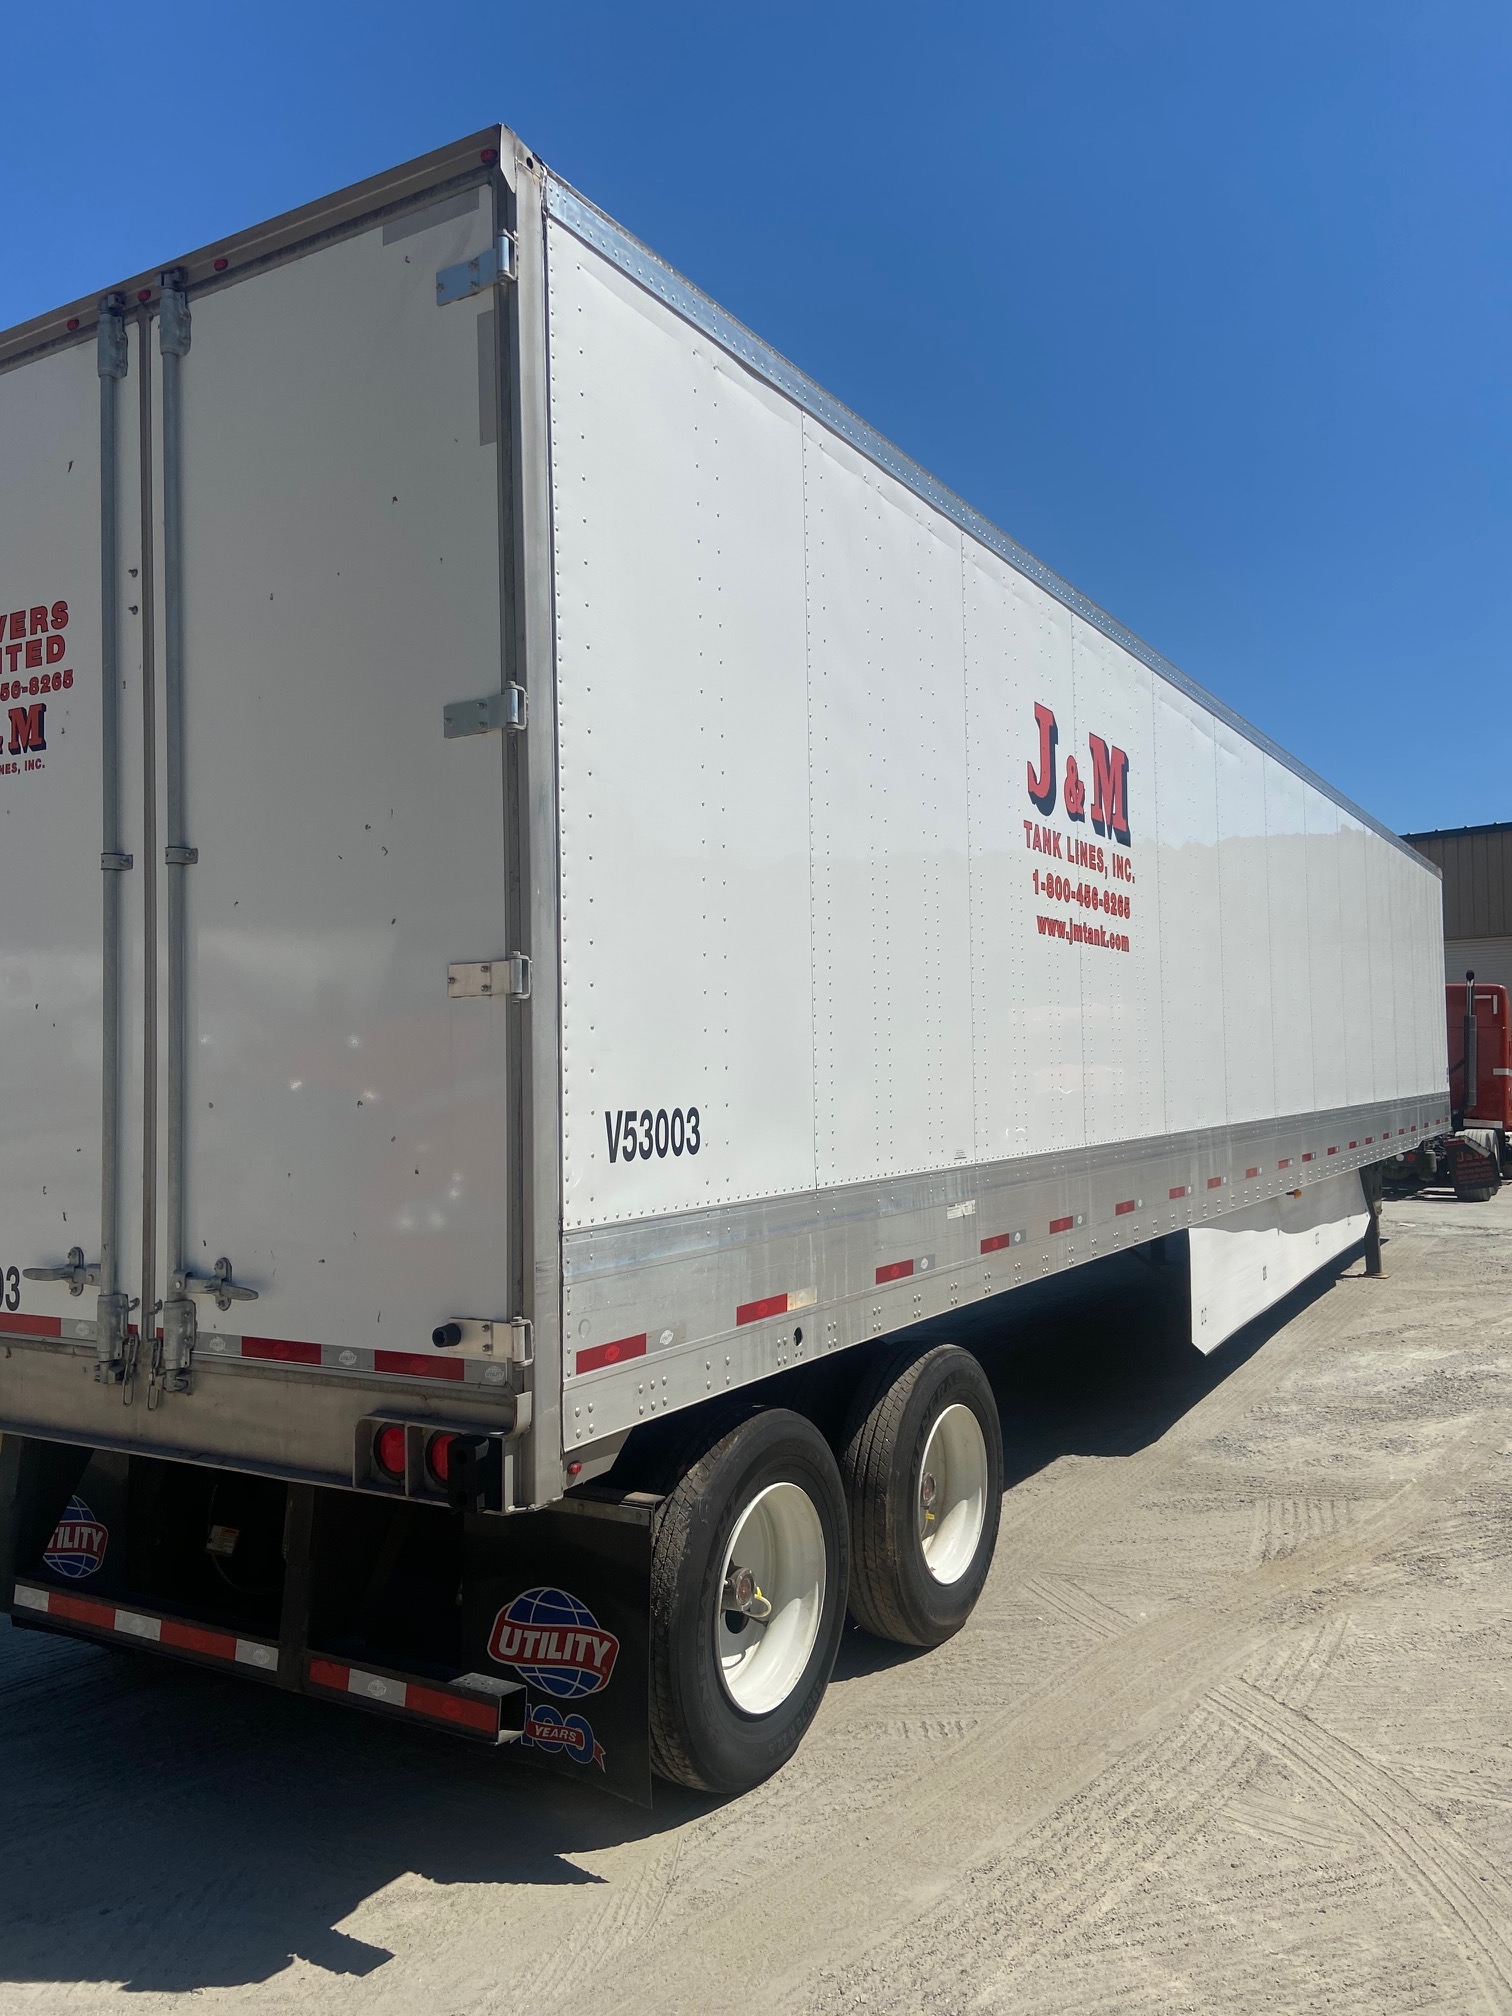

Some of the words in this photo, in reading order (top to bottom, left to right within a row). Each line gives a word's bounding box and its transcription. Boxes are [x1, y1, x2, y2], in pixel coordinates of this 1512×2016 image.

[0, 634, 65, 674] TED
[24, 758, 45, 771] INC.
[1023, 819, 1062, 859] TANK
[1067, 836, 1108, 880] LINES,
[1112, 852, 1135, 884] INC.
[1032, 868, 1131, 919] 1-800-456-8265
[1036, 914, 1130, 952] www.jmtank.com
[604, 1106, 701, 1164] V53003
[0, 1265, 20, 1312] 3
[499, 1625, 612, 1668] UTILITY
[534, 1725, 577, 1742] YEARS
